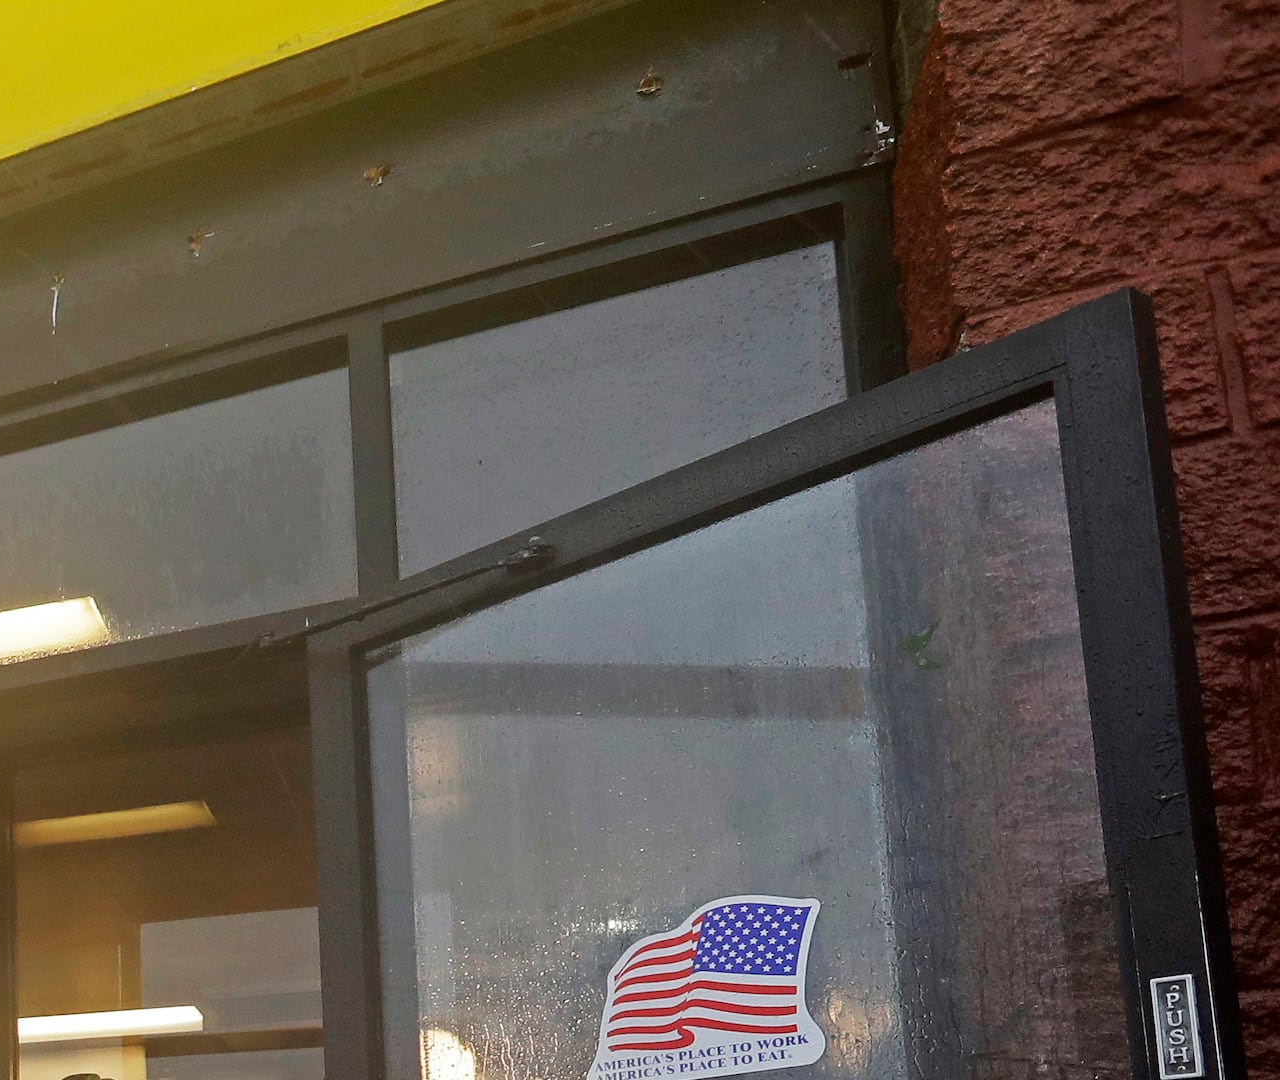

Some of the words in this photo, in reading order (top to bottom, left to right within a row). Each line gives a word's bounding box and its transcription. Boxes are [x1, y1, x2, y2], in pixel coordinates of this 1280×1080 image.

[1165, 992, 1190, 1064] PUSH
[595, 1052, 675, 1073] AMERICA'S
[678, 1046, 725, 1061] PLACE
[729, 1043, 753, 1054] TO
[756, 1034, 809, 1049] WORK
[679, 1058, 727, 1073] PLACE
[731, 1054, 753, 1066] TO
